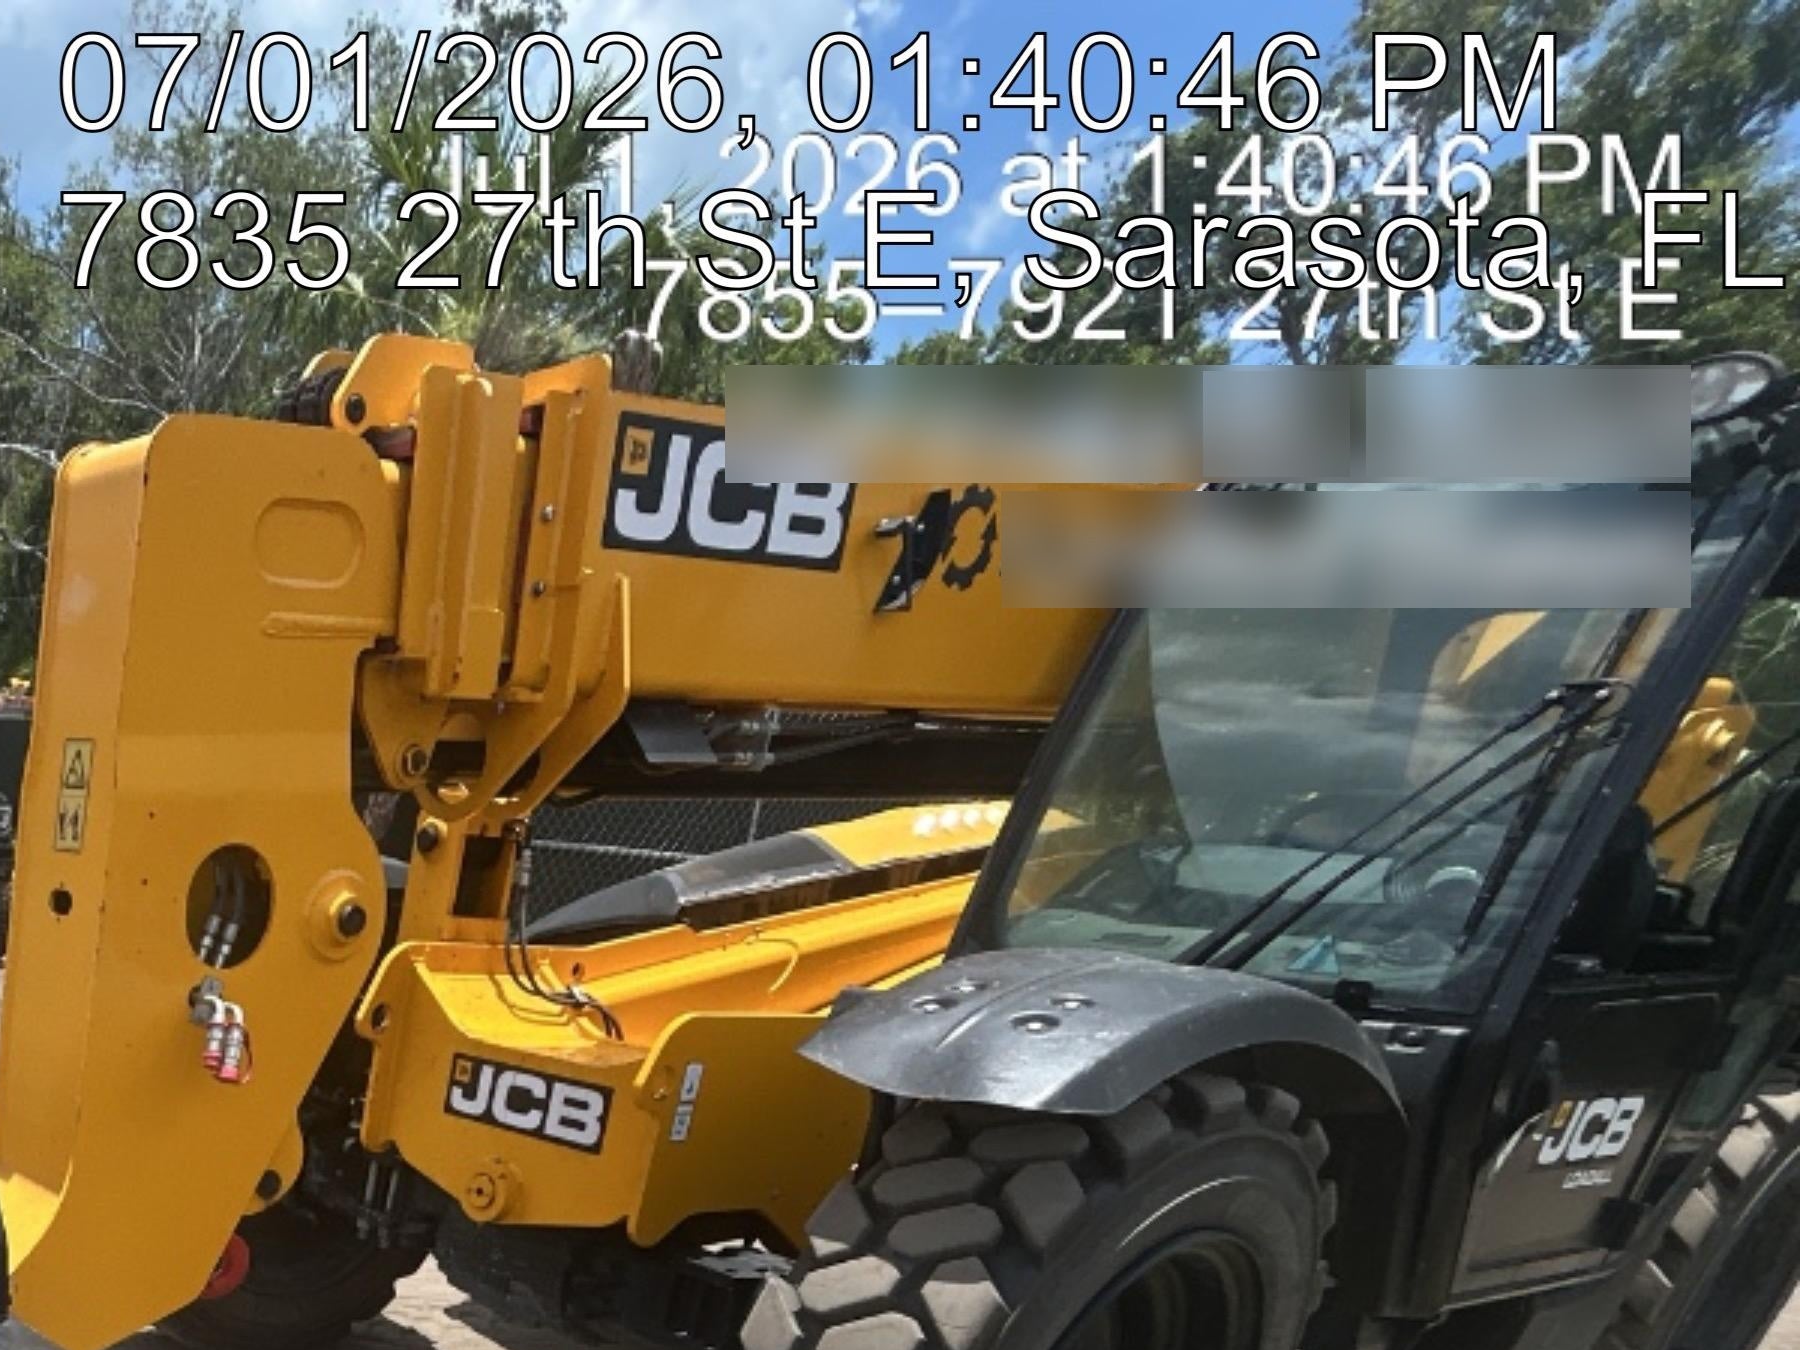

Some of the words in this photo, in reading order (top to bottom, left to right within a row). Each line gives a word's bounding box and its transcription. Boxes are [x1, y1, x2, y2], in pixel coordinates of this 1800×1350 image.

[614, 433, 851, 559] JCB
[450, 1063, 605, 1147] JCB
[1538, 1095, 1645, 1166] JCB
